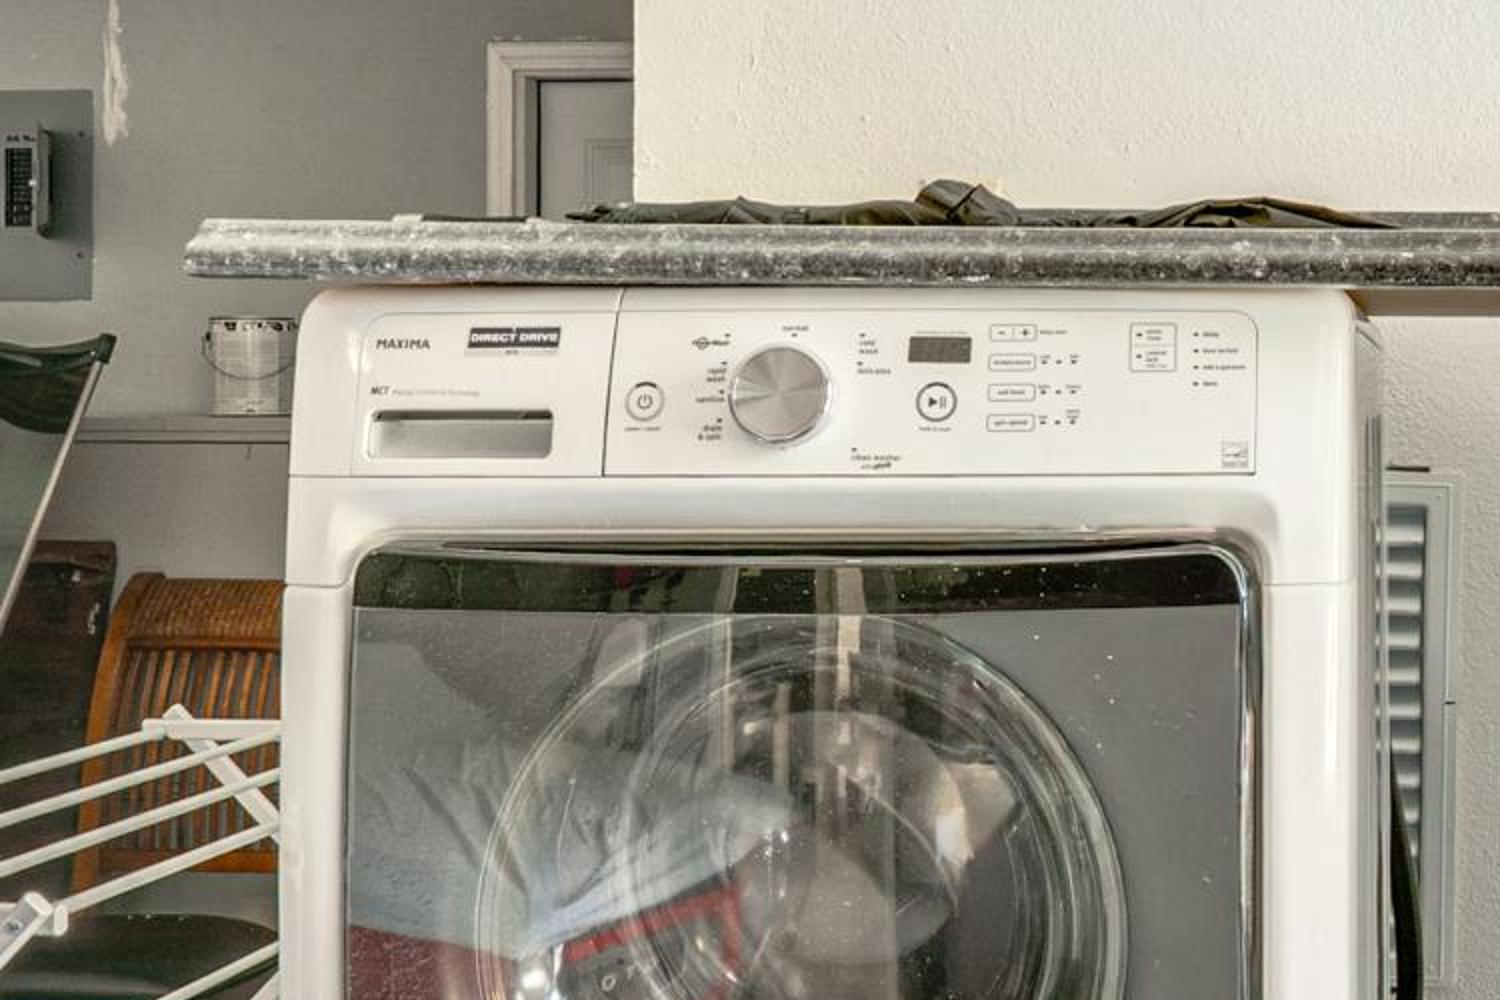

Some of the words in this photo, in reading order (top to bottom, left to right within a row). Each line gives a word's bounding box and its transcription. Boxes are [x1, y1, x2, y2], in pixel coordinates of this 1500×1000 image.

[471, 332, 517, 343] DIRECT
[519, 331, 559, 343] DRIVE
[376, 338, 431, 350] MAXIMA
